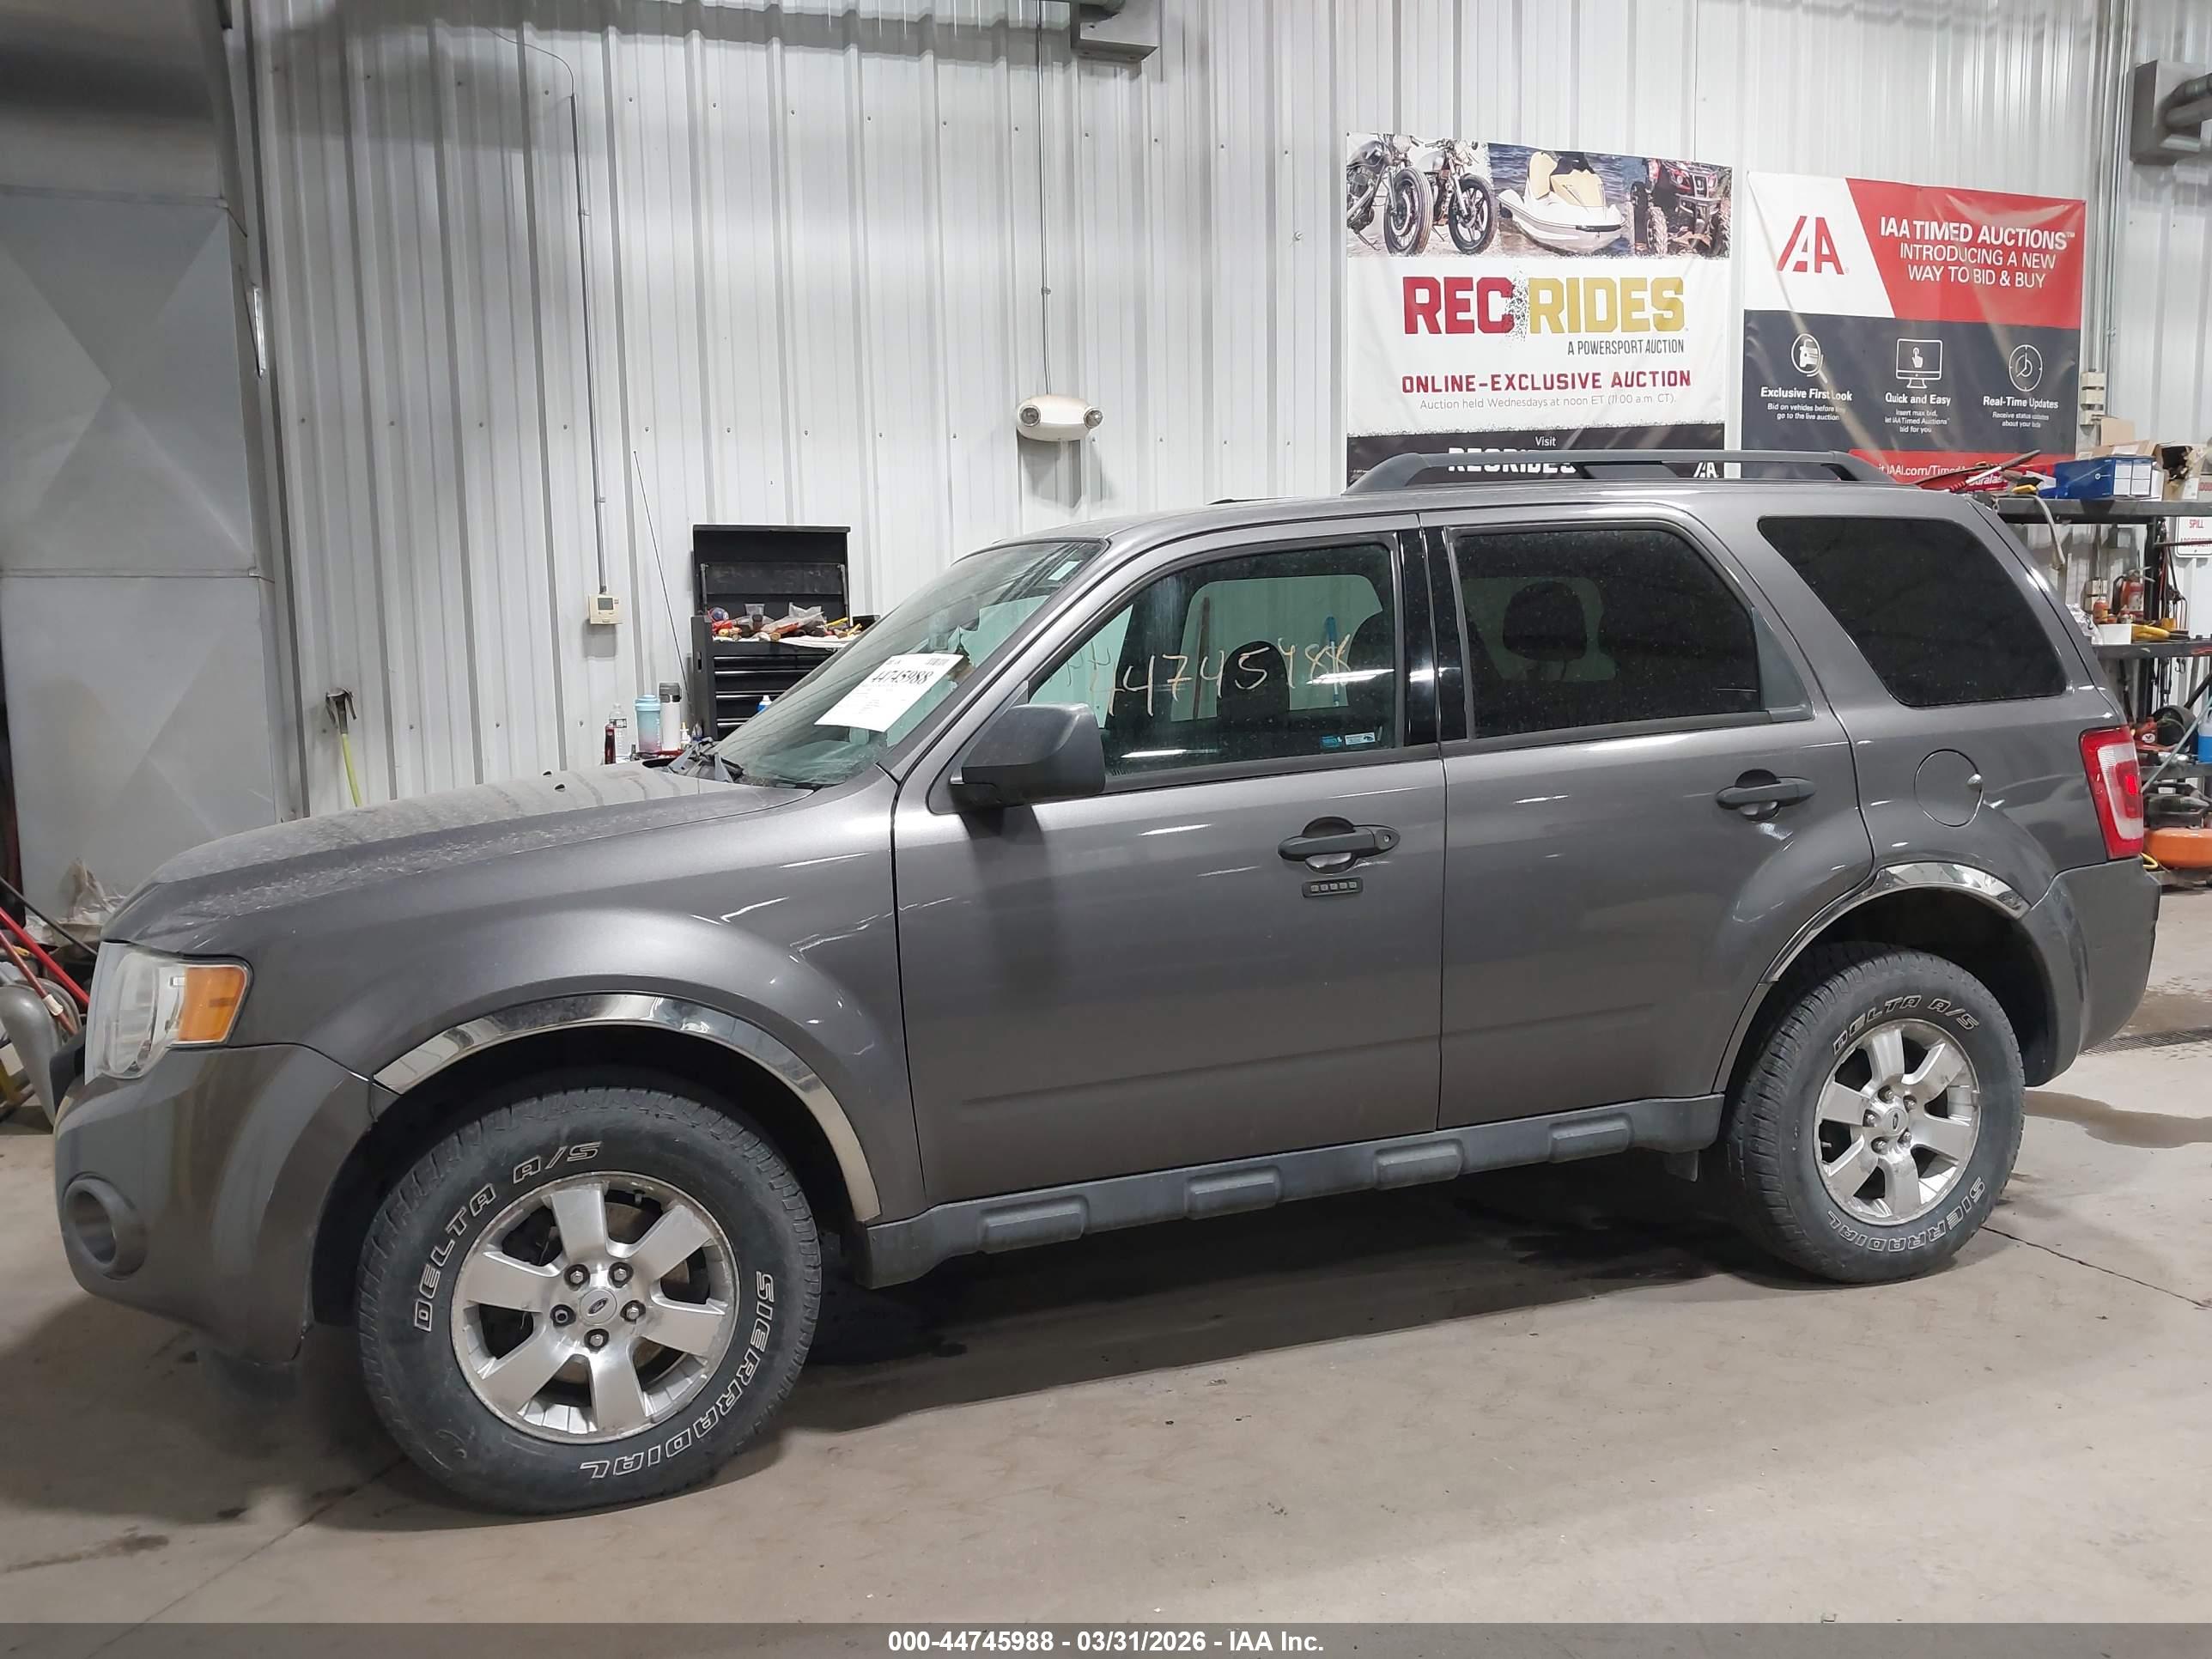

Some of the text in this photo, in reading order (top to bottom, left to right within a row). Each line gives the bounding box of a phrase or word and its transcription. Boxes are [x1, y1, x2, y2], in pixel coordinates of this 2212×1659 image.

[1881, 216, 1911, 239] IAA
[1912, 220, 1972, 242] TIMED
[1899, 242, 2056, 269] INTRODUCING A NEW
[1908, 264, 2046, 289] WAY TO BID & BUY
[1567, 339, 1684, 356] A POWERSPORT AUCTION
[1402, 370, 1692, 393] ONLINE-EXCLUSIVE AUCTION
[1419, 398, 1460, 410] Auction
[1462, 398, 1484, 409] held
[1487, 397, 1547, 410] Wednesdays
[1550, 397, 1560, 406] at
[1563, 397, 1588, 406] noon
[1591, 395, 1604, 405] ET
[1608, 394, 1633, 406] (1100
[1760, 387, 1807, 398] Exclusive
[1808, 388, 1830, 400] First
[1885, 392, 1951, 406] Quick and Easy
[1983, 396, 2059, 409] Real-Time Updates
[1535, 436, 1556, 447] Visit
[1967, 473, 2008, 487] uralas
[1832, 994, 1979, 1055] DELTA A/S
[1827, 1177, 1985, 1252] SIERRADIAL
[414, 1141, 602, 1331] DELTA A/S
[580, 1271, 774, 1479] SIERRADIAL
